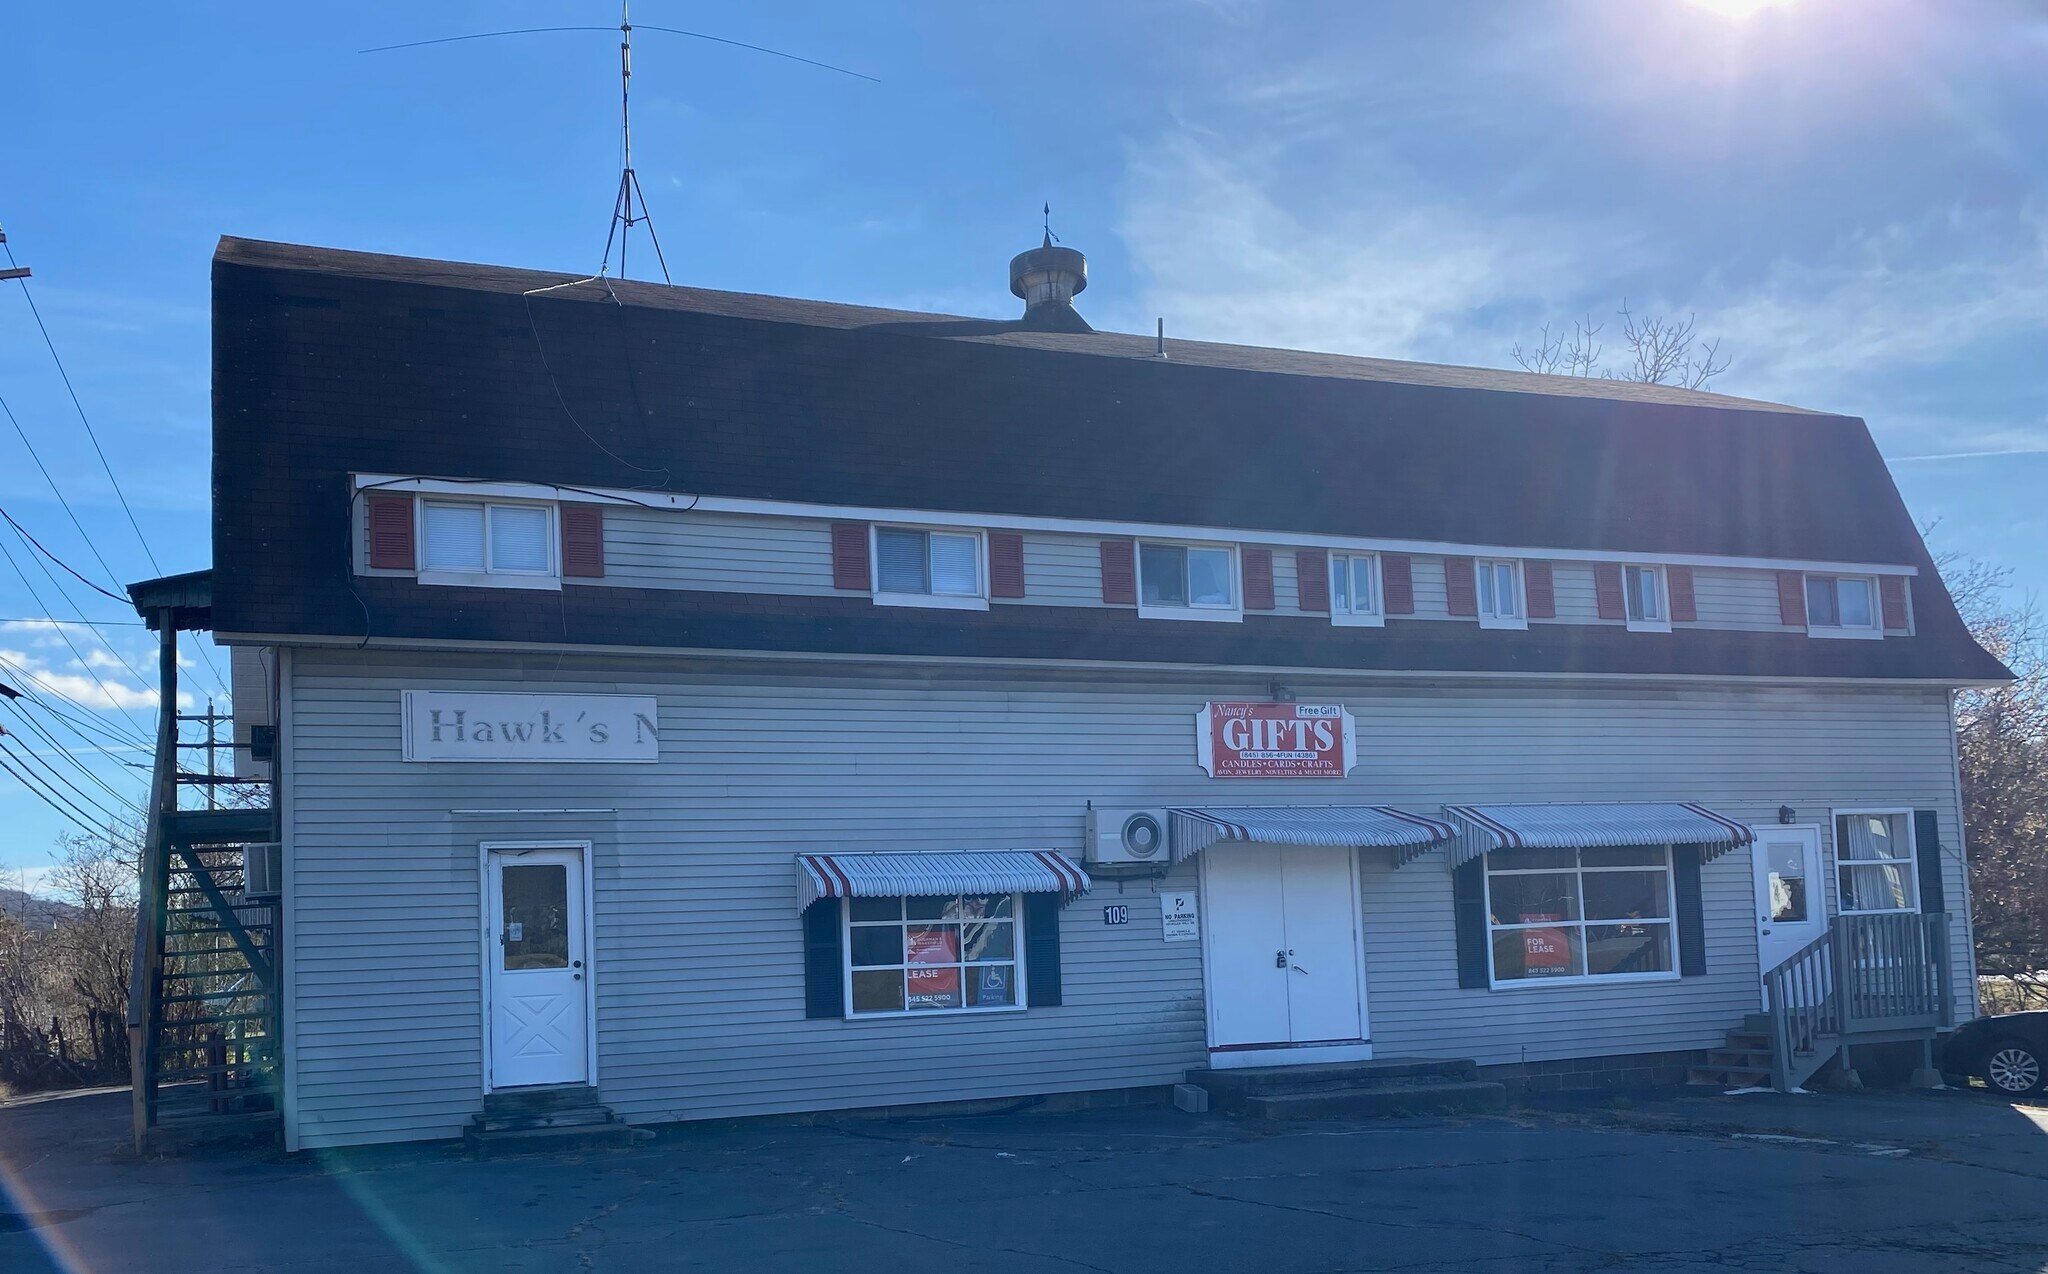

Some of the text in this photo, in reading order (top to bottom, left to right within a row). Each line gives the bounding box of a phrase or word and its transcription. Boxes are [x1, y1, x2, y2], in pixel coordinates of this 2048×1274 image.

[1214, 704, 1253, 719] Nancy's
[1299, 706, 1337, 715] Free Gift
[429, 709, 609, 743] Hawk's
[1222, 719, 1334, 752] GIFTS
[1222, 760, 1334, 768] CANDLES CARDS CRAFTS
[1105, 906, 1127, 923] 109
[1527, 938, 1544, 946] FOR
[1528, 945, 1554, 954] LEASE
